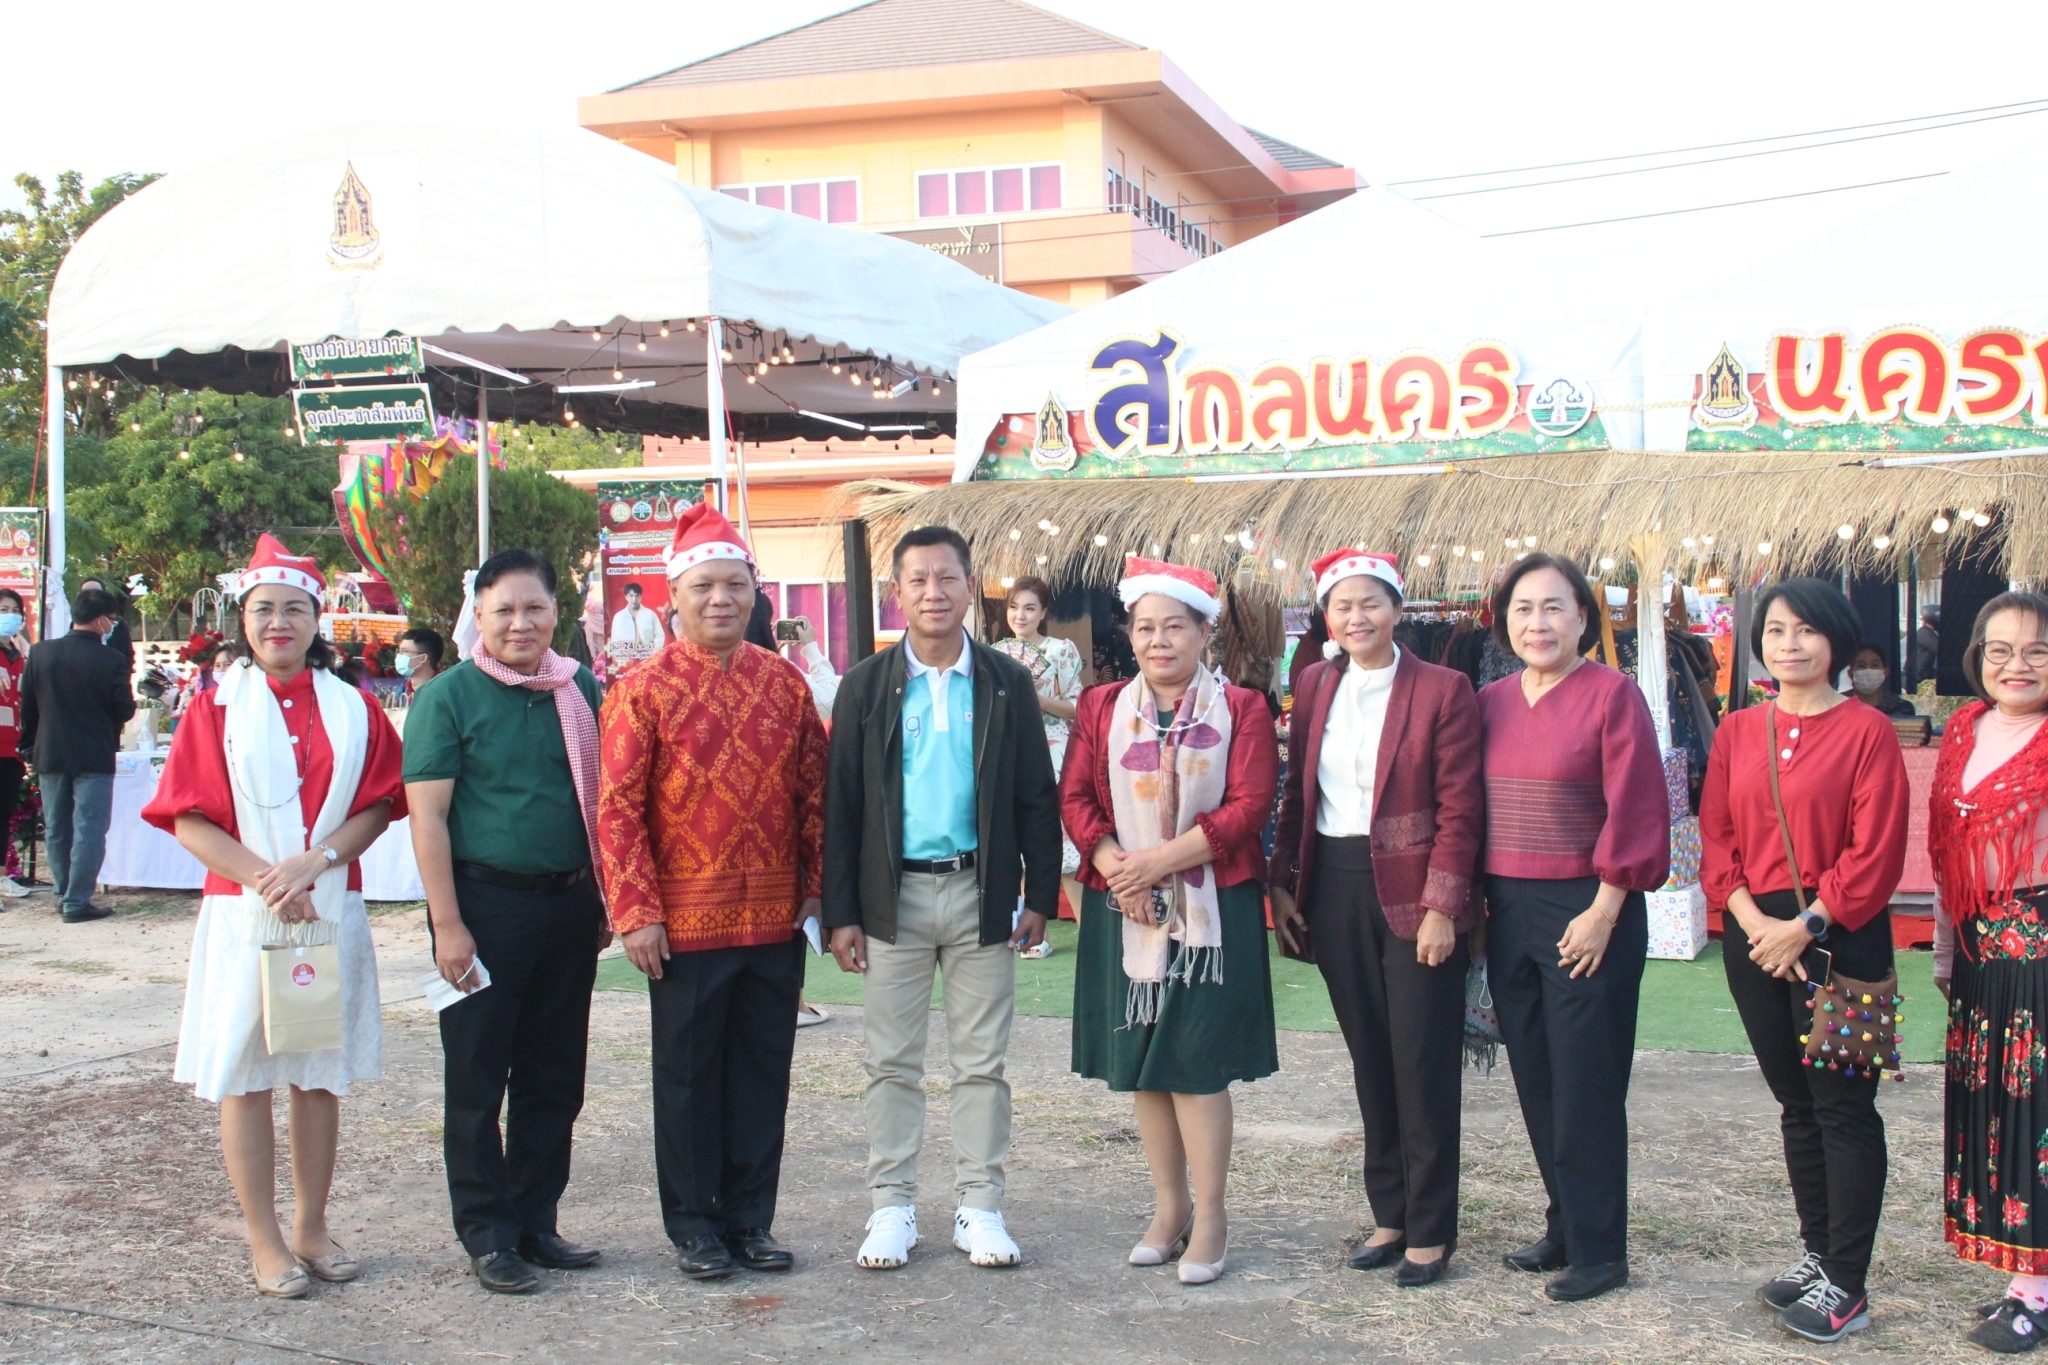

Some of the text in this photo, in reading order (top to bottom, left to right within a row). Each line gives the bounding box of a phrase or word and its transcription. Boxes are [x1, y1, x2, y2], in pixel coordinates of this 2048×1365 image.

[302, 336, 411, 366] จุดอำนวยการ
[1769, 329, 2048, 420] นคร
[305, 400, 424, 431] จุดประชาสัมพันธ์
[1089, 328, 1514, 452] สกลนคร
